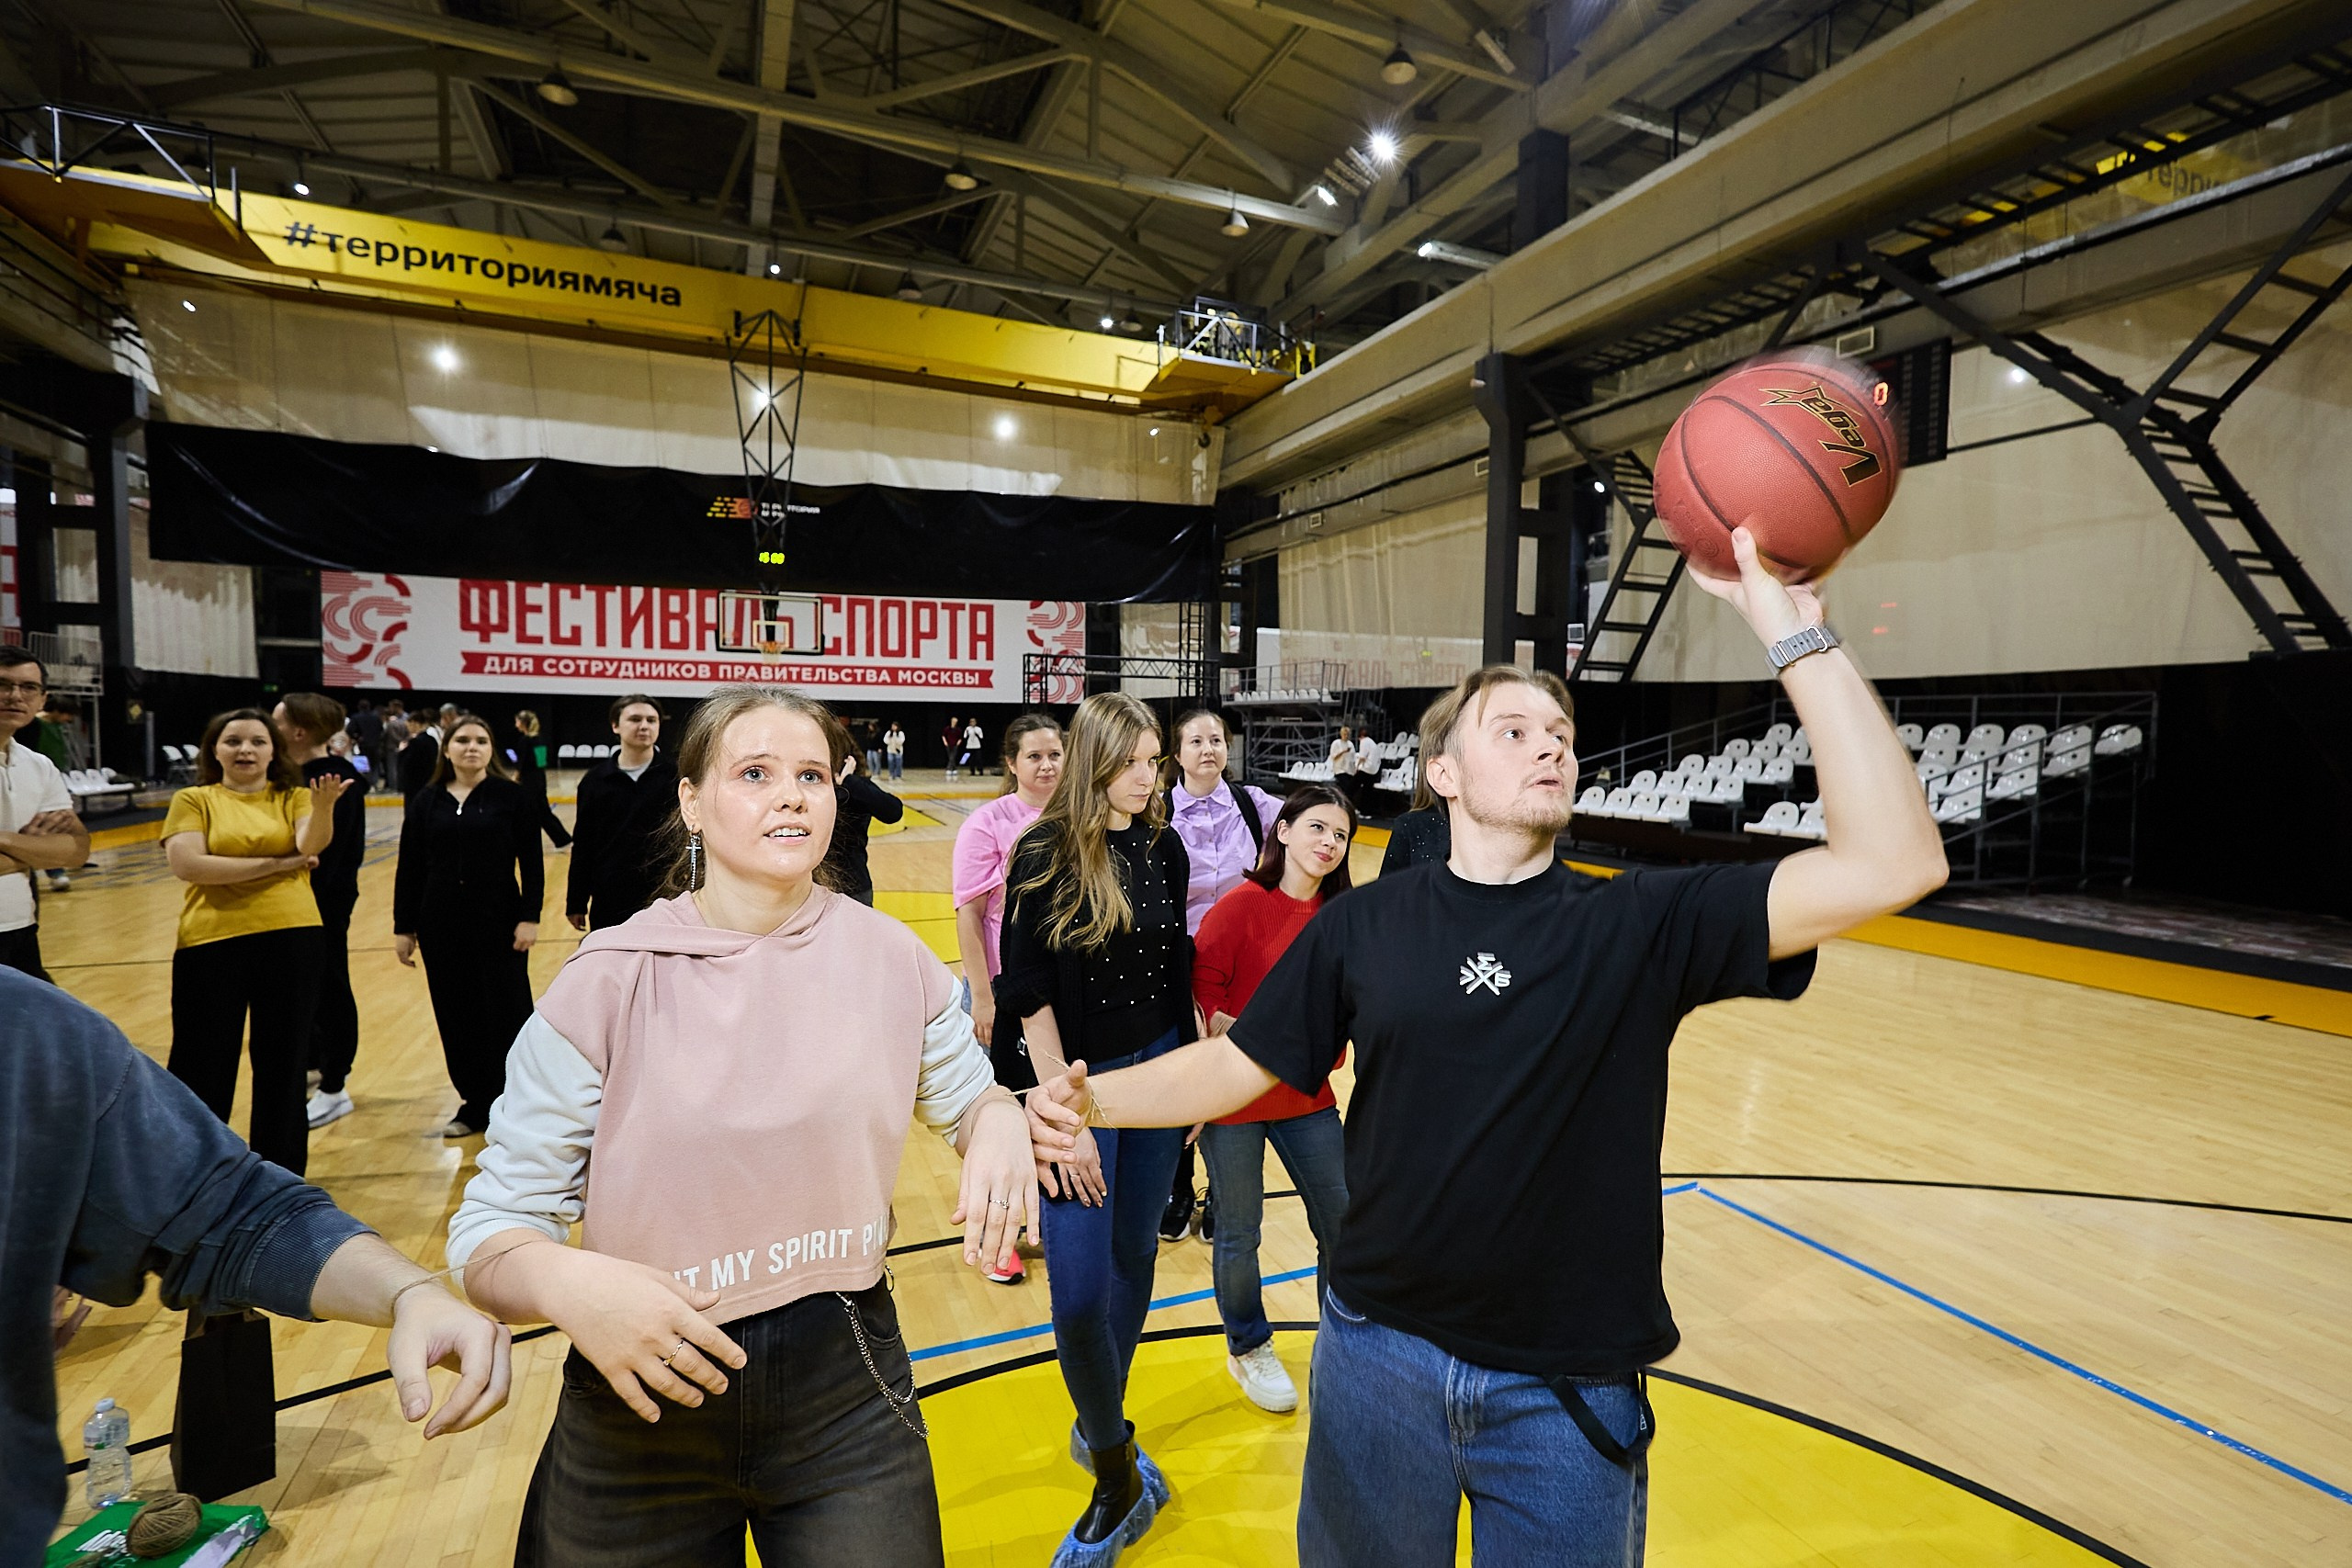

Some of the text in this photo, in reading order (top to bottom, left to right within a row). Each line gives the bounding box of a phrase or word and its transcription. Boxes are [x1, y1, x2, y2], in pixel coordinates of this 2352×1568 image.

[286, 220, 683, 307] #территориямяча
[1801, 395, 1883, 488] Vega
[814, 595, 994, 661] СПОРТА
[483, 656, 979, 685] ДЛЯ СОТРУДНИКОВ ПРАВИТЕЛЬСТВА МОСКВЫ
[711, 1249, 755, 1291] MY
[768, 1228, 853, 1274] SPIRIT
